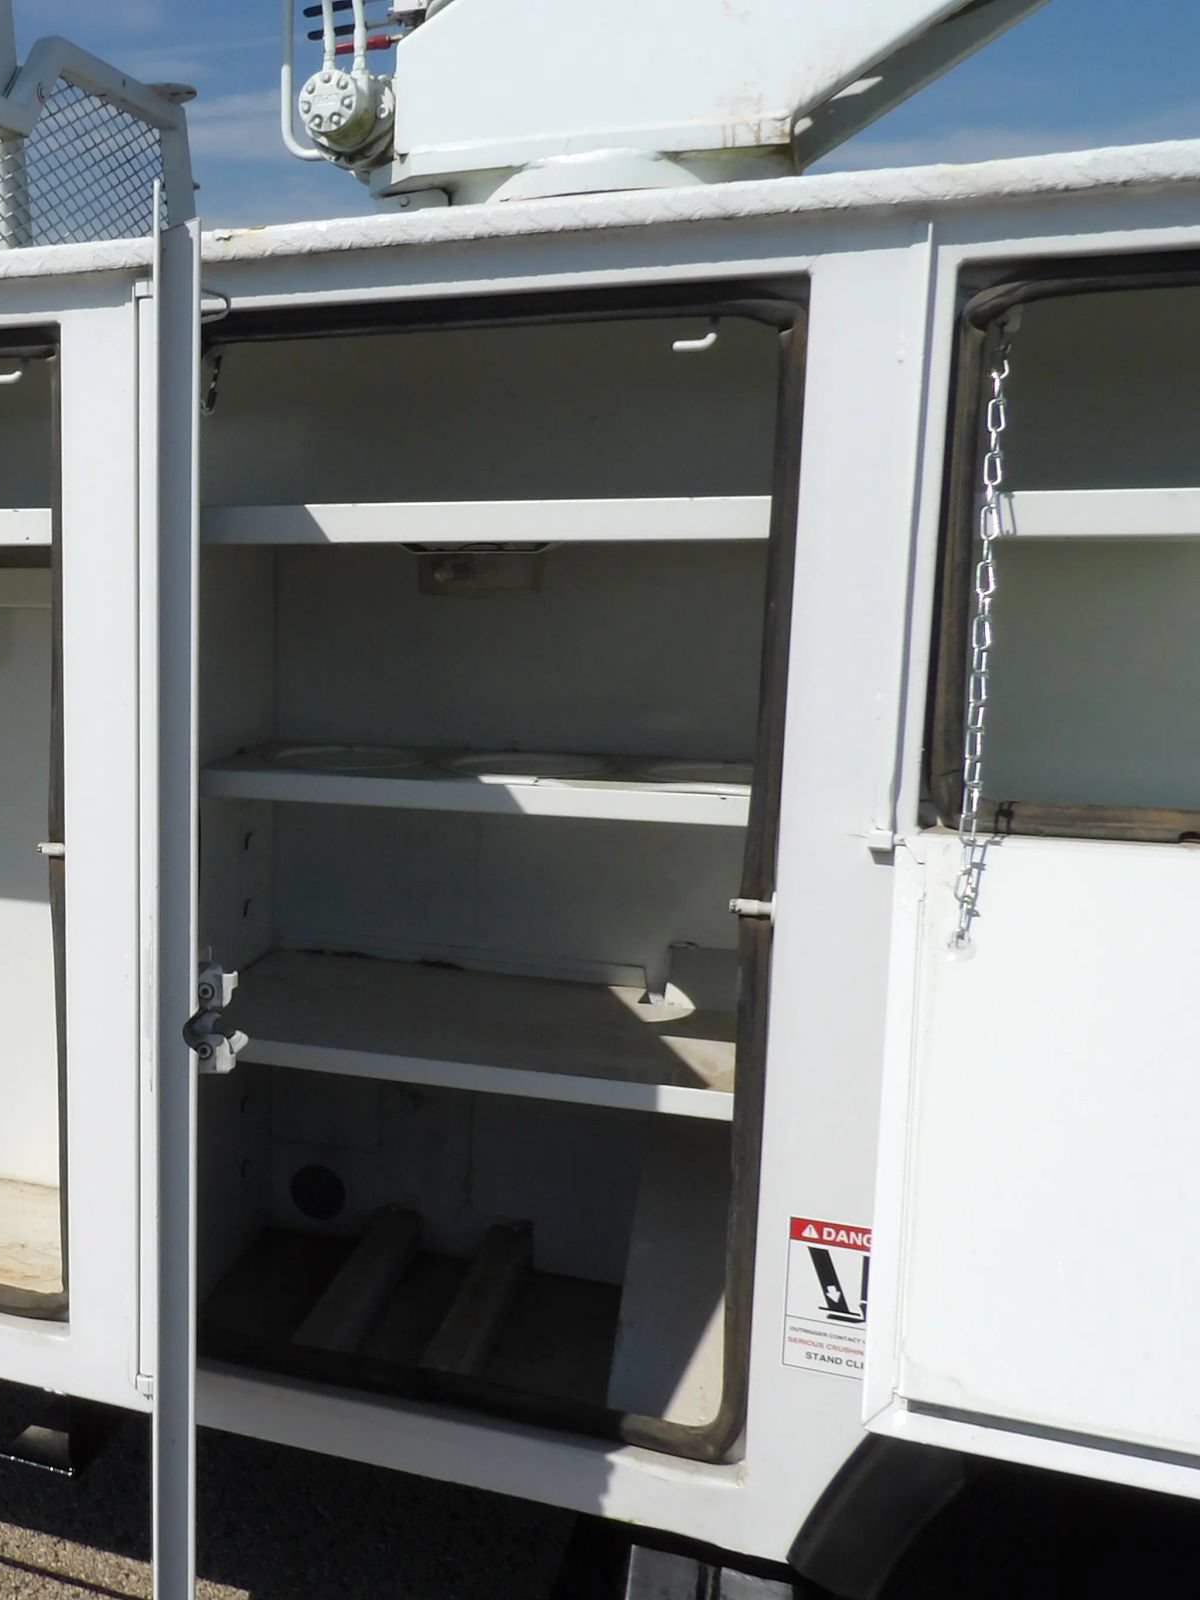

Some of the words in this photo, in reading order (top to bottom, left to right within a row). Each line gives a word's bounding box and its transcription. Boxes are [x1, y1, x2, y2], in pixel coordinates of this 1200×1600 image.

[822, 1227, 872, 1247] DANG
[788, 1336, 824, 1348] SERIOUS
[826, 1343, 864, 1356] CRUSHIN
[829, 1333, 861, 1343] CONTACT
[805, 1351, 842, 1365] STAND
